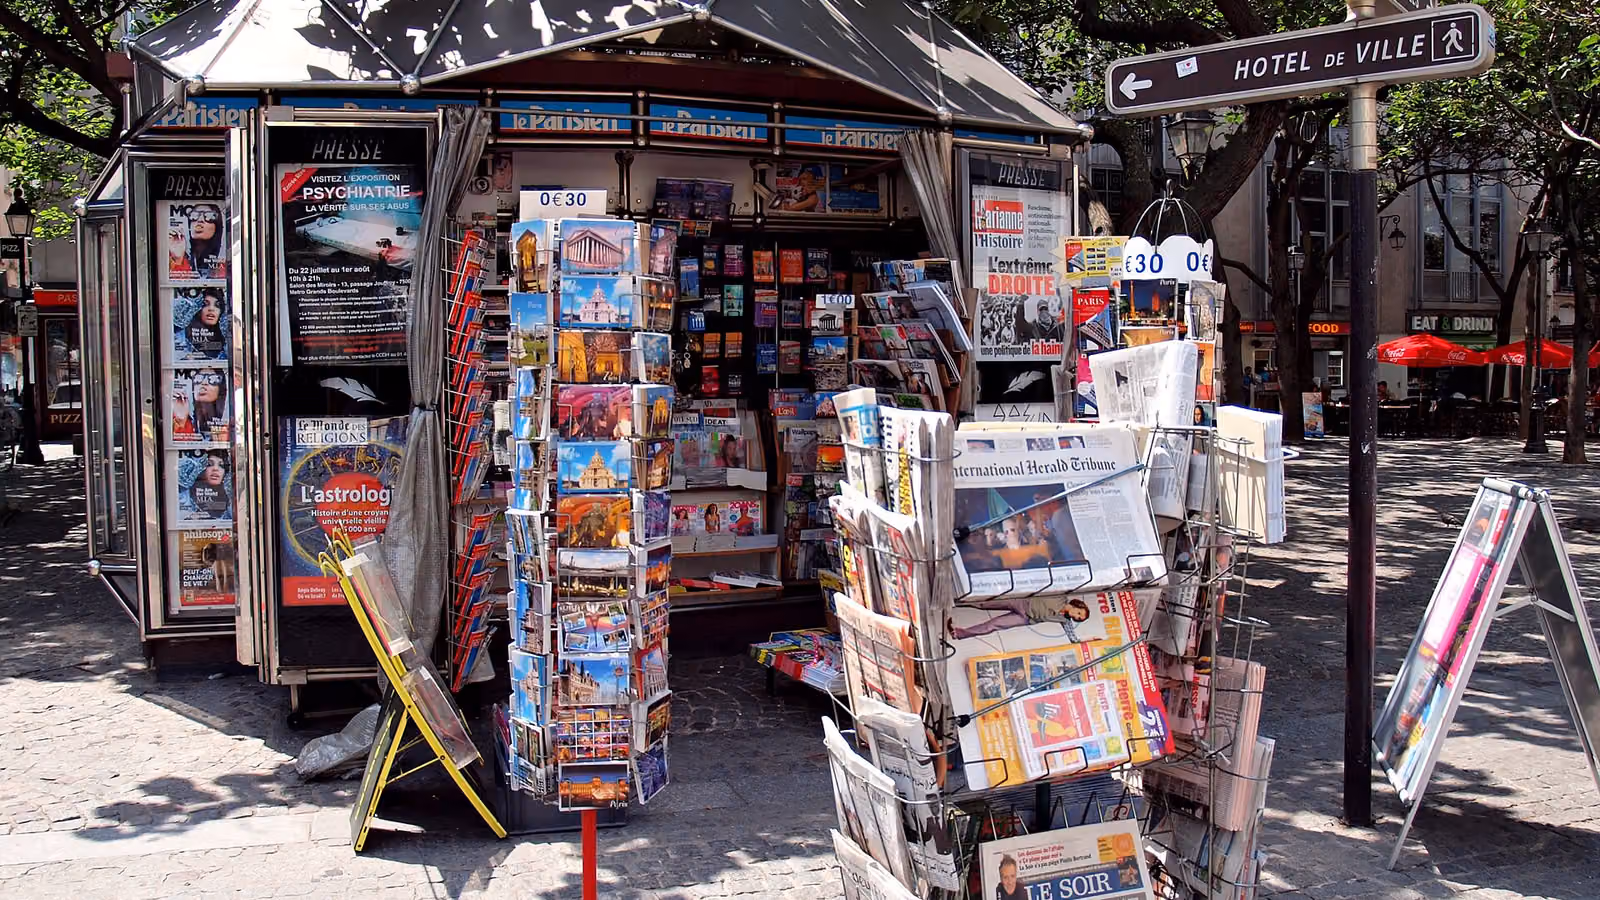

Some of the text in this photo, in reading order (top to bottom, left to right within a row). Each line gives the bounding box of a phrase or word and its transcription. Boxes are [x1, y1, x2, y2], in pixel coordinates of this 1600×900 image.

[1234, 34, 1426, 80] HOTEL DE VILLE
[529, 105, 618, 131] Parisien
[821, 130, 833, 145] le
[312, 138, 385, 160] PRESSE
[311, 174, 400, 183] VISITEZ L'EXPOSITION
[997, 161, 1046, 187] PRESSE
[165, 175, 225, 197] PRESSE
[303, 184, 411, 200] PSYCHIATRIE
[318, 202, 348, 212] VÉRITÉ
[350, 203, 368, 211] SUR
[369, 202, 385, 210] SES
[387, 202, 410, 210] ABUS
[540, 192, 587, 206] 0€30
[975, 233, 1024, 249] l'Histoire
[310, 266, 330, 275] juillet
[988, 274, 1056, 297] DROITE
[1077, 296, 1105, 306] PARIS
[1308, 323, 1339, 334] FOOD
[1411, 315, 1493, 332] EAT & DRINK
[981, 345, 994, 356] une
[994, 343, 1023, 358] politique
[1023, 342, 1031, 355] de
[1032, 339, 1041, 355] la
[310, 418, 350, 430] Monde
[297, 431, 367, 444] RELIGIONS
[953, 457, 1117, 479] nternational Herald Tribune
[363, 516, 386, 525] vieille
[1132, 640, 1148, 687] CEPTIONNELLE
[1140, 646, 1151, 670] RICHARD
[1147, 671, 1153, 679] EN
[1148, 679, 1157, 693] DVD
[1116, 679, 1134, 722] Pierre
[1024, 872, 1113, 900] LE SOIR
